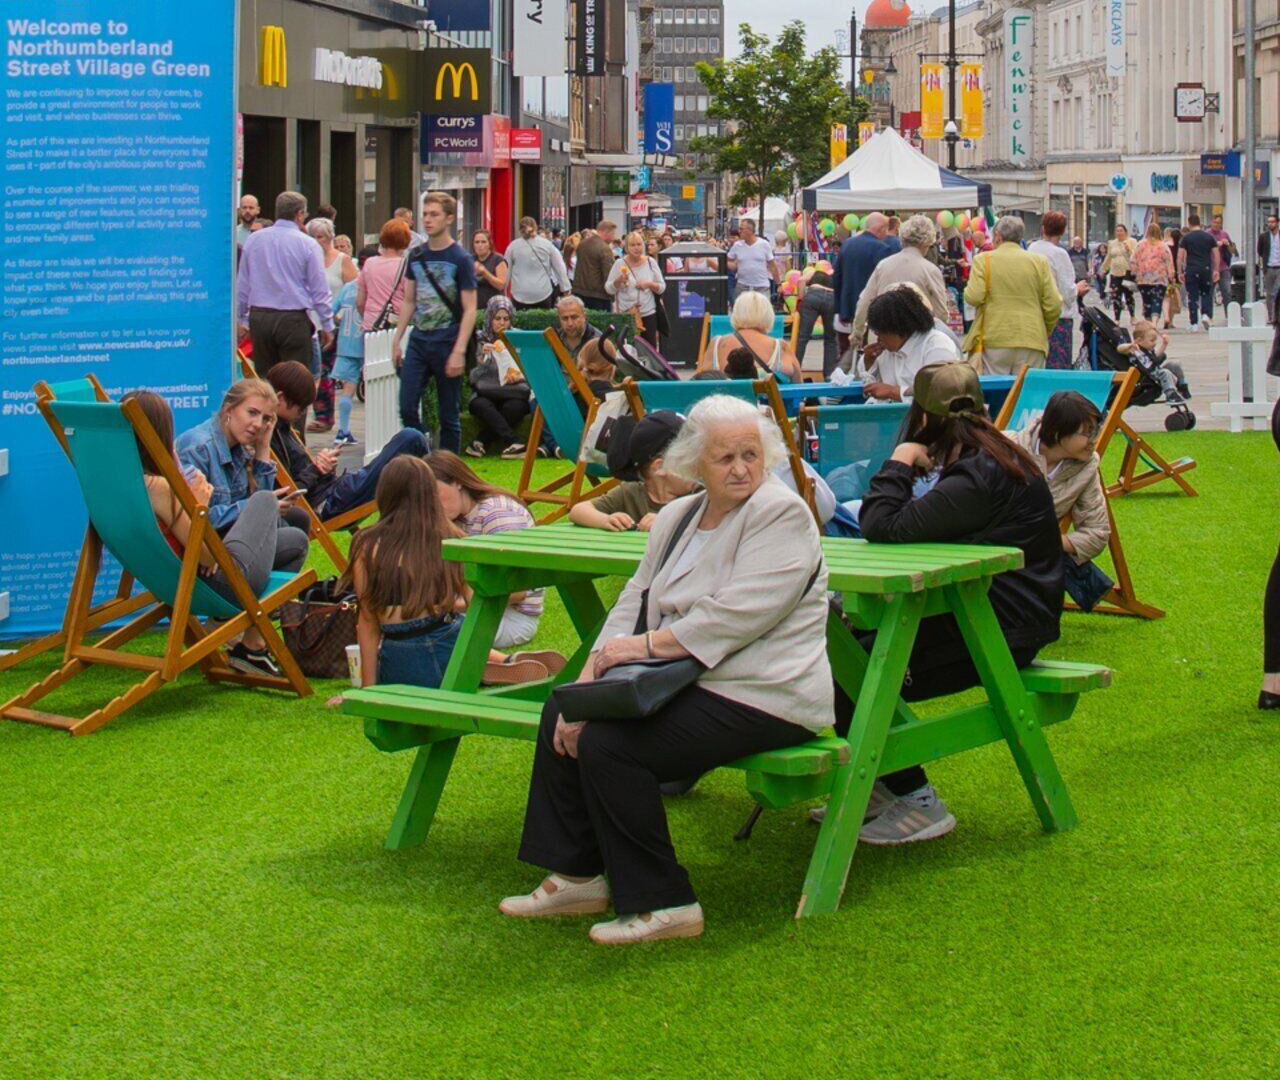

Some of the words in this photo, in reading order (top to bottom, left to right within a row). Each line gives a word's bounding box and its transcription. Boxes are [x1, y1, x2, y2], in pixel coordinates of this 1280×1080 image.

[7, 19, 102, 36] Welcome
[107, 21, 128, 35] to
[585, 27, 595, 54] KING
[7, 39, 173, 56] Northumberland
[7, 59, 71, 76] Street
[76, 59, 146, 78] Village
[151, 60, 210, 77] Green
[1009, 15, 1031, 156] Fenwick
[7, 88, 20, 98] We
[23, 90, 37, 98] are
[39, 88, 83, 100] continuing
[95, 88, 128, 100] improve
[131, 90, 144, 98] our
[146, 88, 161, 100] city
[6, 101, 37, 113] provide
[47, 101, 69, 112] great
[71, 101, 123, 110] environment
[125, 101, 137, 110] for
[139, 100, 167, 112] people
[180, 100, 201, 110] work
[6, 112, 22, 122] and
[45, 112, 61, 122] and
[63, 112, 89, 122] where
[91, 112, 138, 122] businesses
[437, 116, 475, 129] currys
[434, 137, 448, 148] PC
[449, 137, 478, 148] World
[6, 149, 32, 158] Street
[45, 148, 69, 158] make
[86, 148, 111, 158] better
[113, 148, 136, 160] place
[151, 149, 189, 159] everyone
[192, 147, 208, 157] that
[5, 185, 26, 195] Over
[28, 185, 41, 194] the
[44, 186, 73, 194] course
[86, 184, 99, 194] the
[169, 184, 199, 195] trialling
[12, 198, 45, 207] number
[58, 197, 116, 209] improvements
[119, 196, 134, 206] and
[137, 198, 152, 208] you
[171, 196, 200, 207] expect
[15, 211, 31, 219] see
[41, 211, 66, 221] range
[137, 208, 174, 220] including
[176, 208, 207, 220] seating
[78, 340, 190, 352] www.newcastle.gov.uk/
[2, 355, 110, 364] northumberlandstreet
